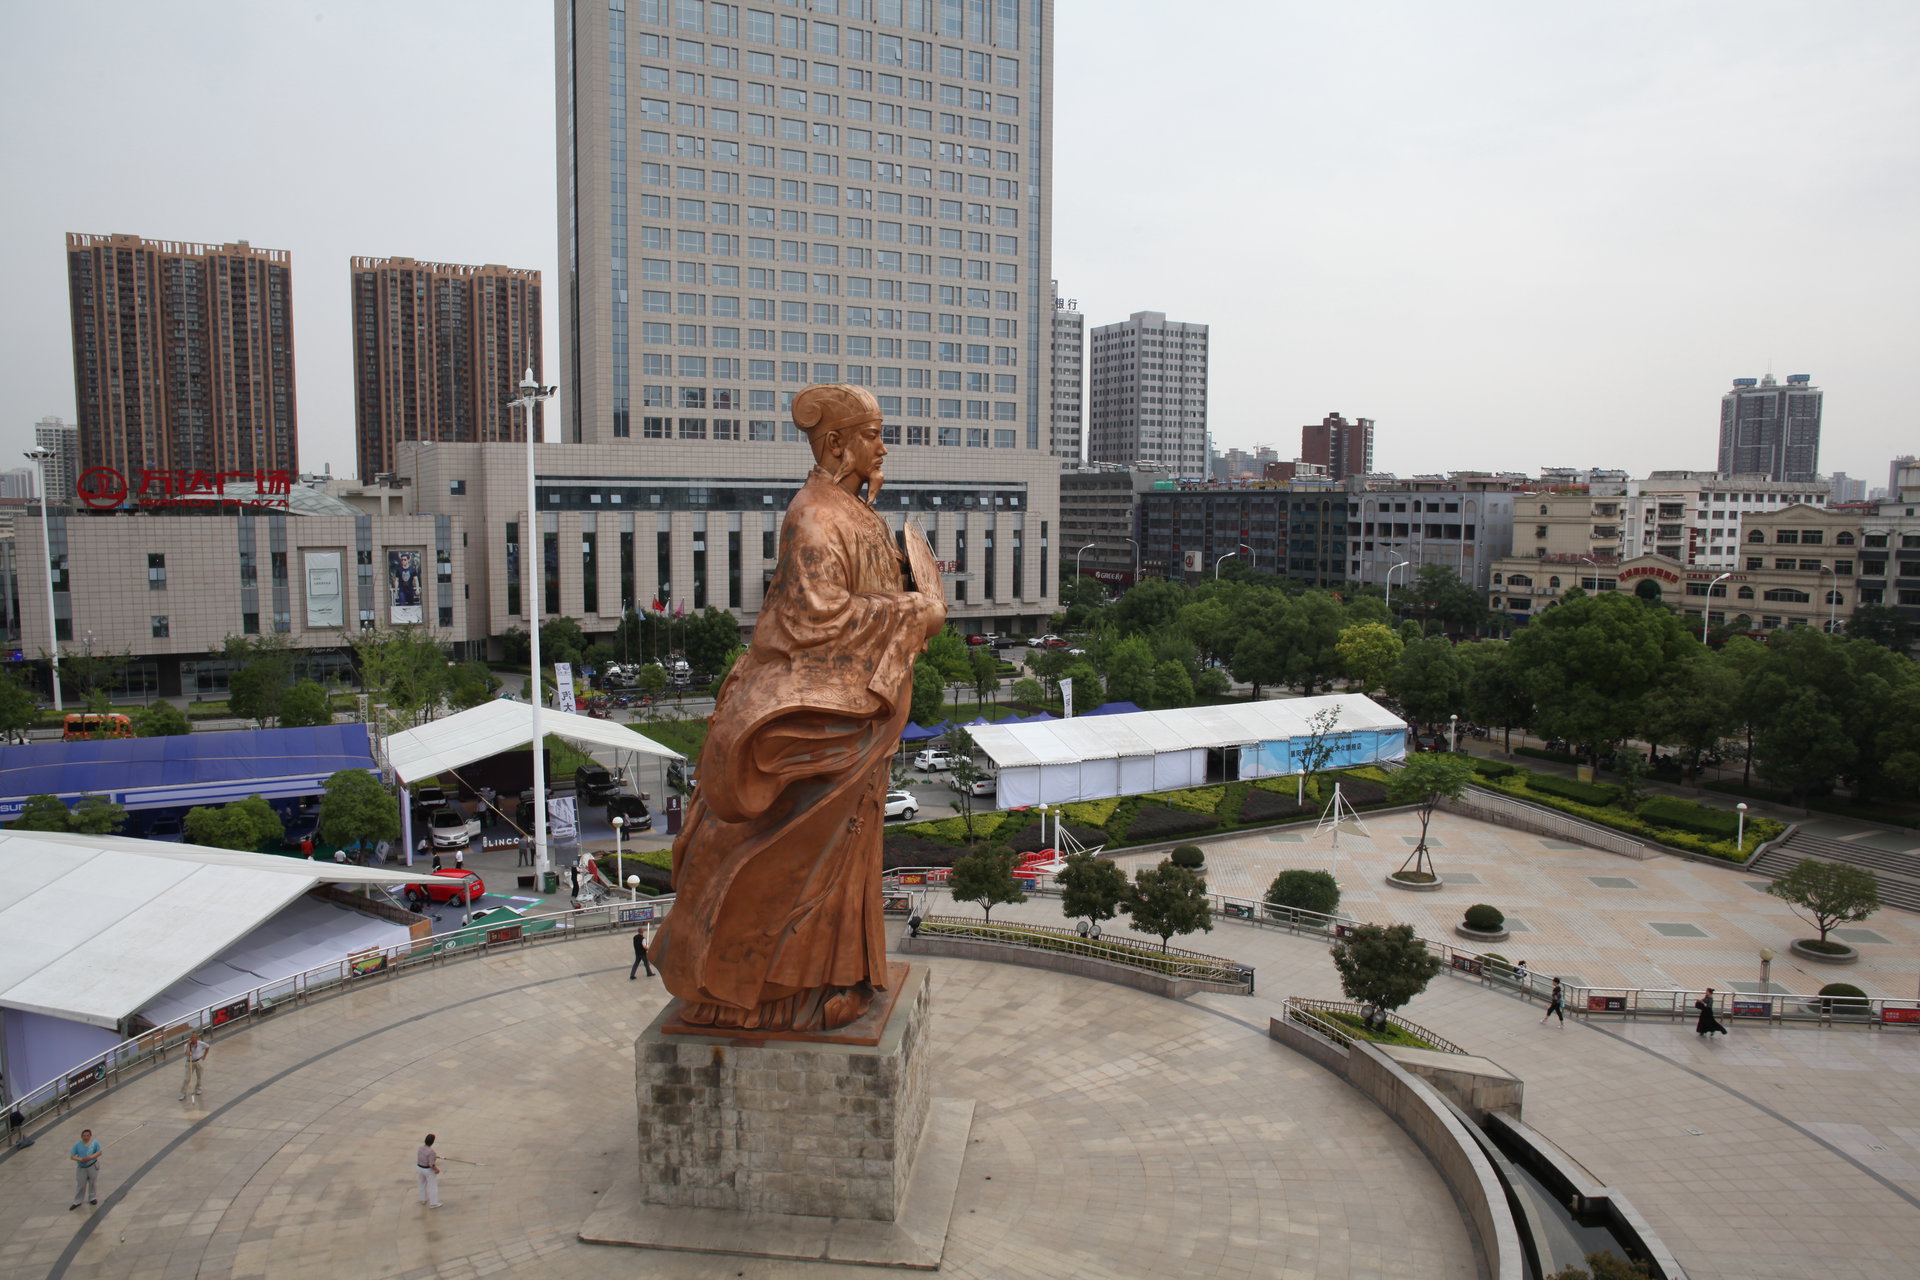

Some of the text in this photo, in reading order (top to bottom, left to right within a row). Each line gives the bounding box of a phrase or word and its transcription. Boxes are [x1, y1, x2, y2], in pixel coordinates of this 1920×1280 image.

[135, 469, 291, 495] 万达广场
[138, 498, 290, 507] WANDA PLAZA
